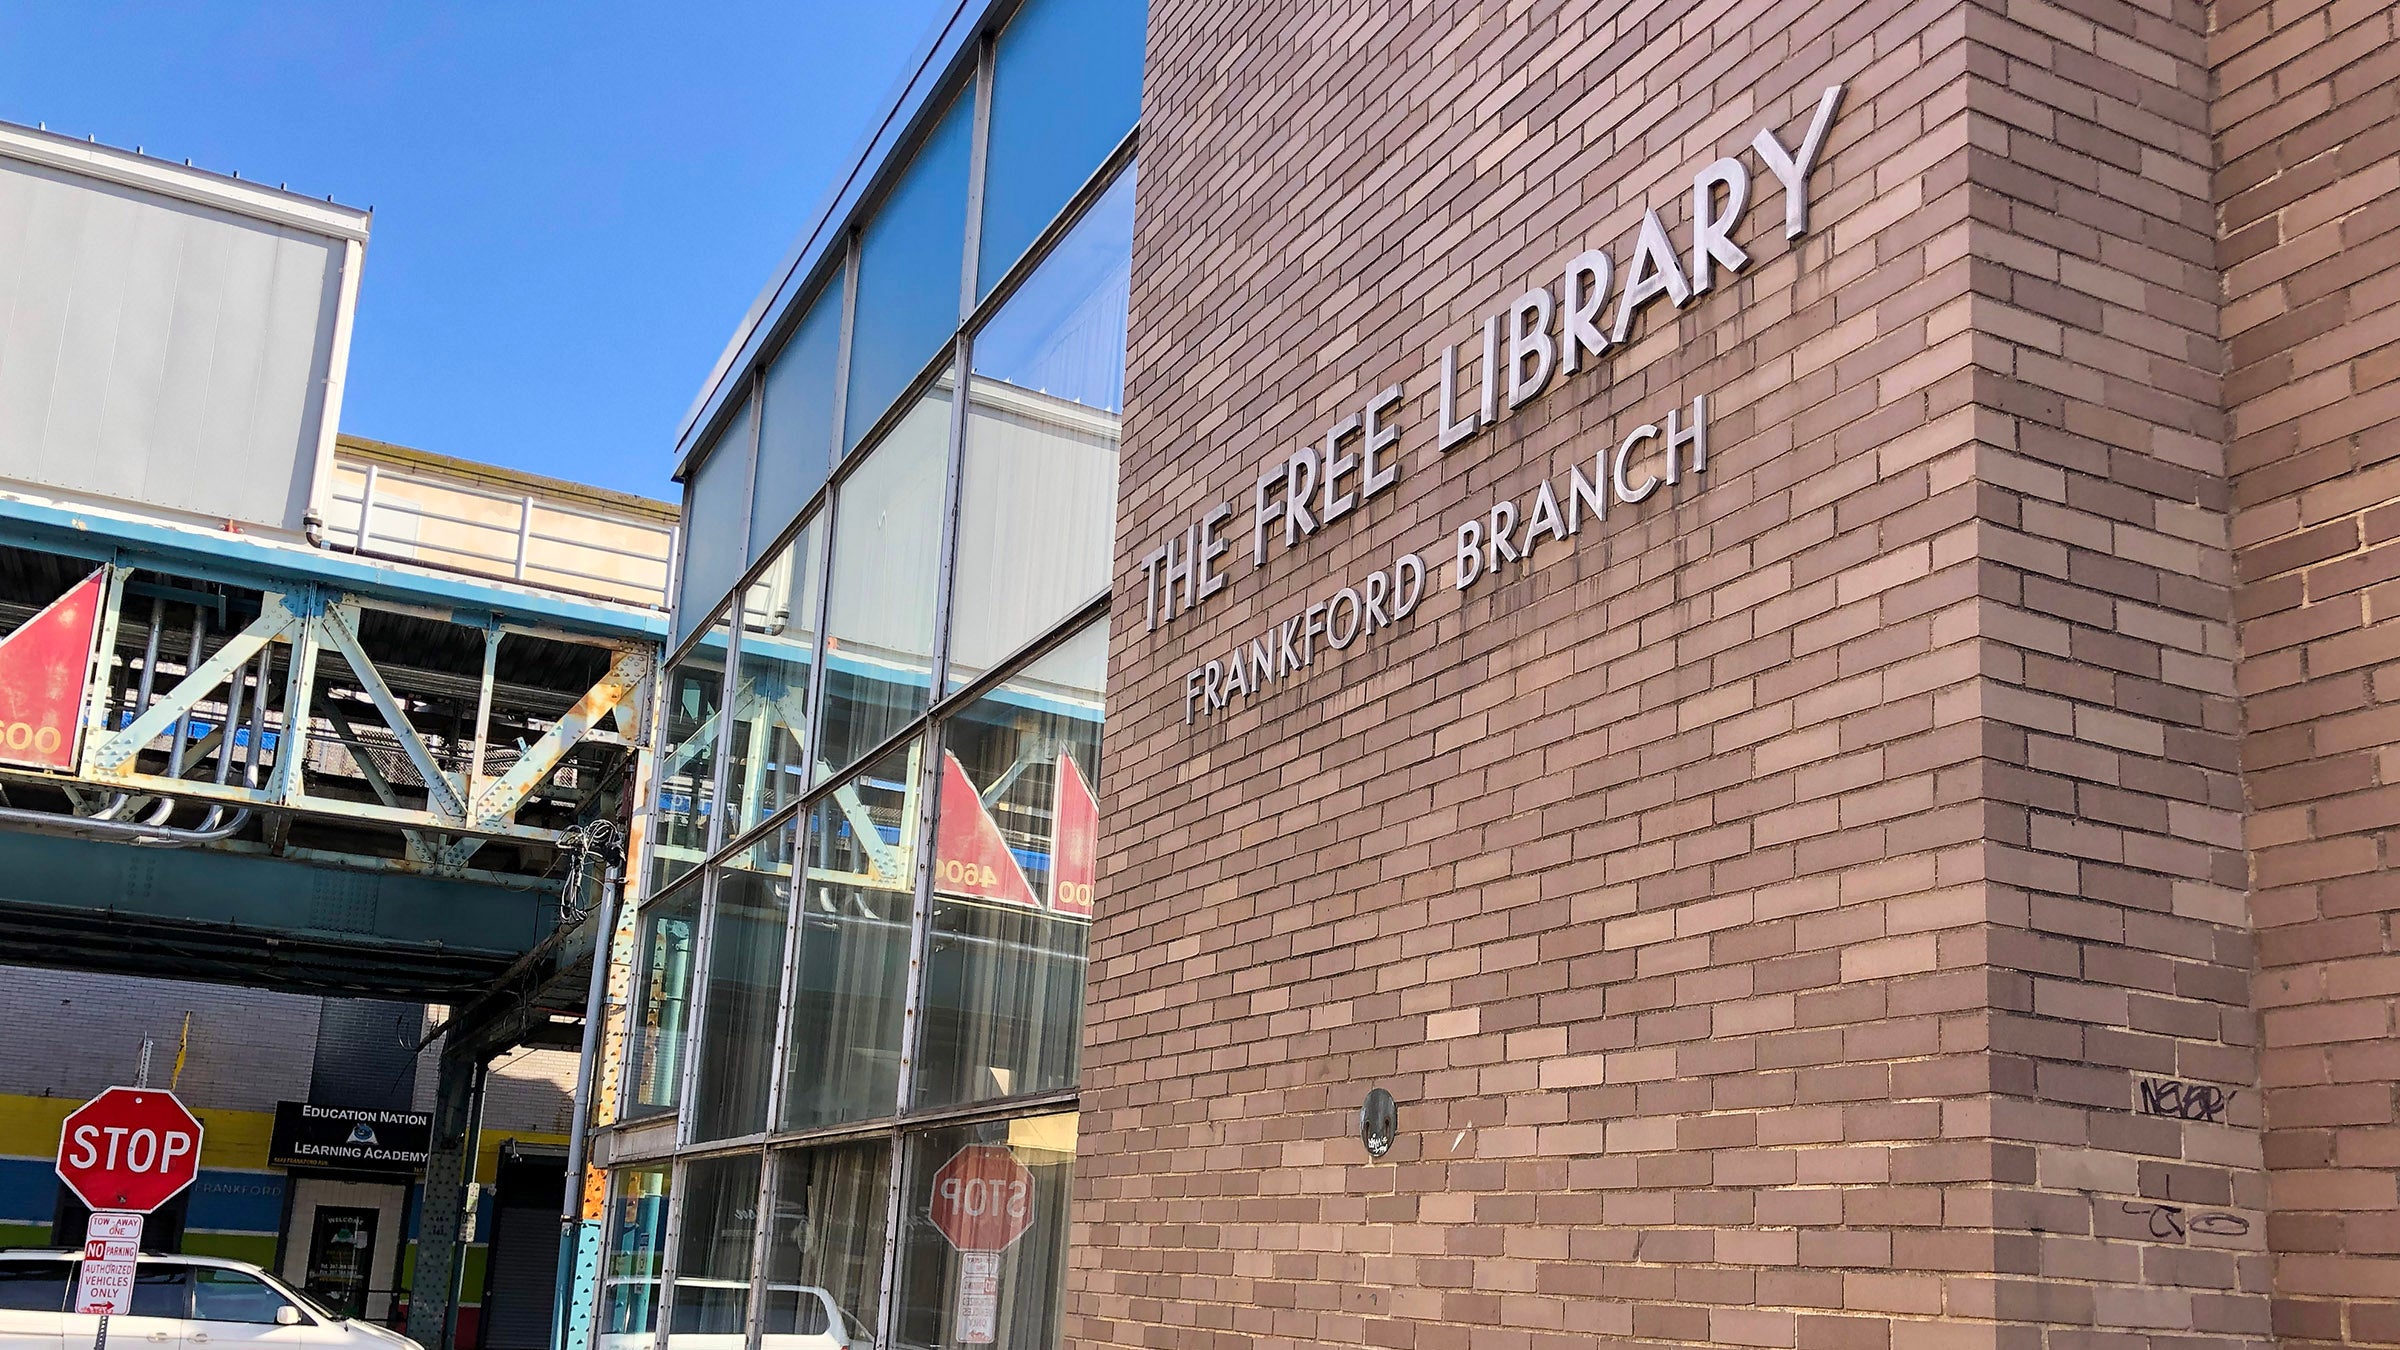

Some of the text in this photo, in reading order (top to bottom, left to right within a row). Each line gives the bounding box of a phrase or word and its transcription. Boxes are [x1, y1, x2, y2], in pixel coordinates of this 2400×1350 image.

[1140, 85, 1848, 633] THE FREE LIBRARY
[1185, 394, 1708, 725] FRANKFORD BRANCH
[0, 720, 61, 754] 00
[302, 1105, 427, 1126] EDUCATION NATION
[69, 1124, 191, 1174] STOP
[294, 1141, 429, 1163] LEARNING ACADEMY
[195, 1183, 282, 1197] FRANKFORD
[93, 1217, 110, 1225] TOW
[116, 1218, 138, 1226] AWAY
[86, 1243, 134, 1258] NO PARKING
[85, 1263, 132, 1275] AUTHORIZED
[85, 1276, 128, 1287] VEHICLES
[90, 1287, 119, 1298] ONLY
